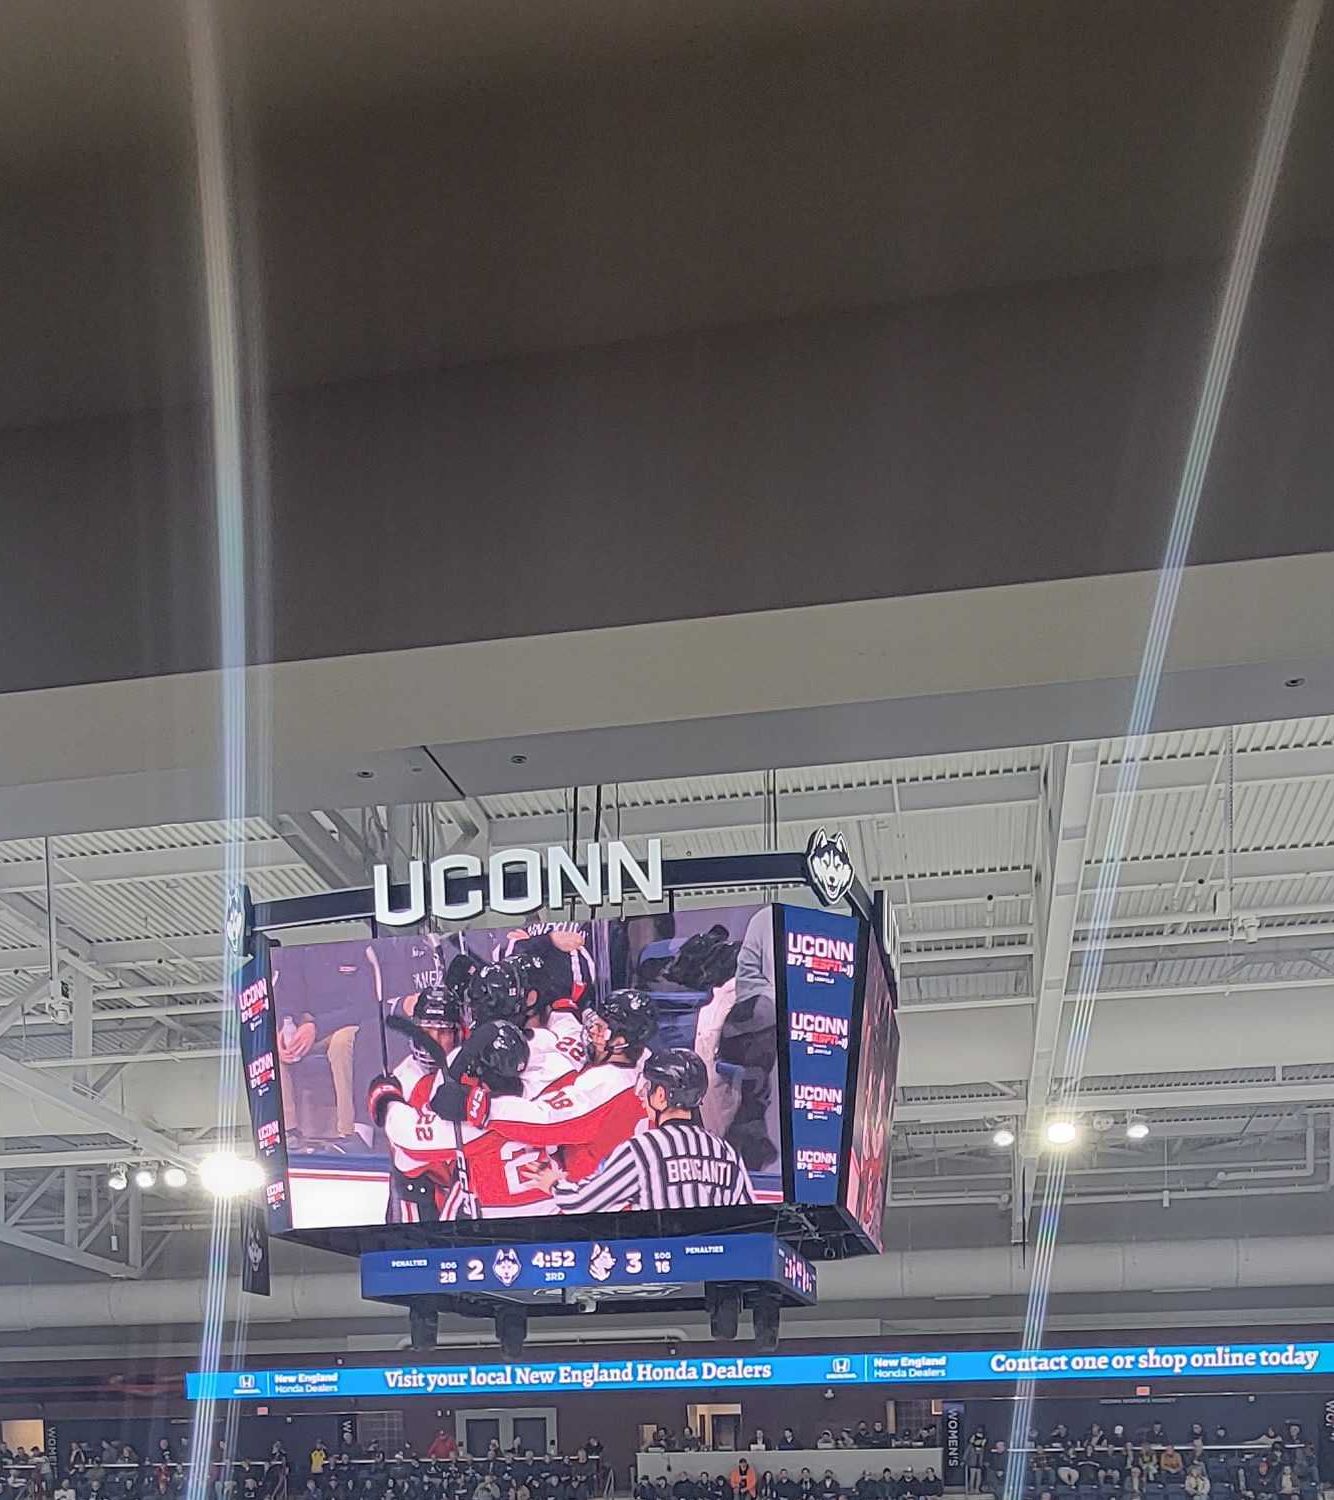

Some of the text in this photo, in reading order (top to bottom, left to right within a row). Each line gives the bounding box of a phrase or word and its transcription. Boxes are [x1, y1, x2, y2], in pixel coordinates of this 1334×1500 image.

[373, 838, 663, 926] UCONN
[788, 932, 854, 962] UCONN
[239, 977, 268, 1010] UCONN
[791, 1012, 848, 1036] UCONN
[248, 1052, 274, 1079] UCONN
[794, 1084, 843, 1104] UCONN
[797, 1150, 837, 1165] UCONN
[467, 1259, 485, 1281] 2
[531, 1250, 576, 1269] 4:52
[625, 1252, 643, 1274] 3
[545, 1271, 565, 1282] 3RD
[874, 1356, 946, 1369] New England
[991, 1347, 1319, 1373] Contact one or shop online today
[275, 1371, 338, 1384] New England
[385, 1361, 772, 1391] Visit your local New England Honda Dealers
[874, 1367, 946, 1379] Honda Dealers
[275, 1384, 338, 1393] Honda Dealers
